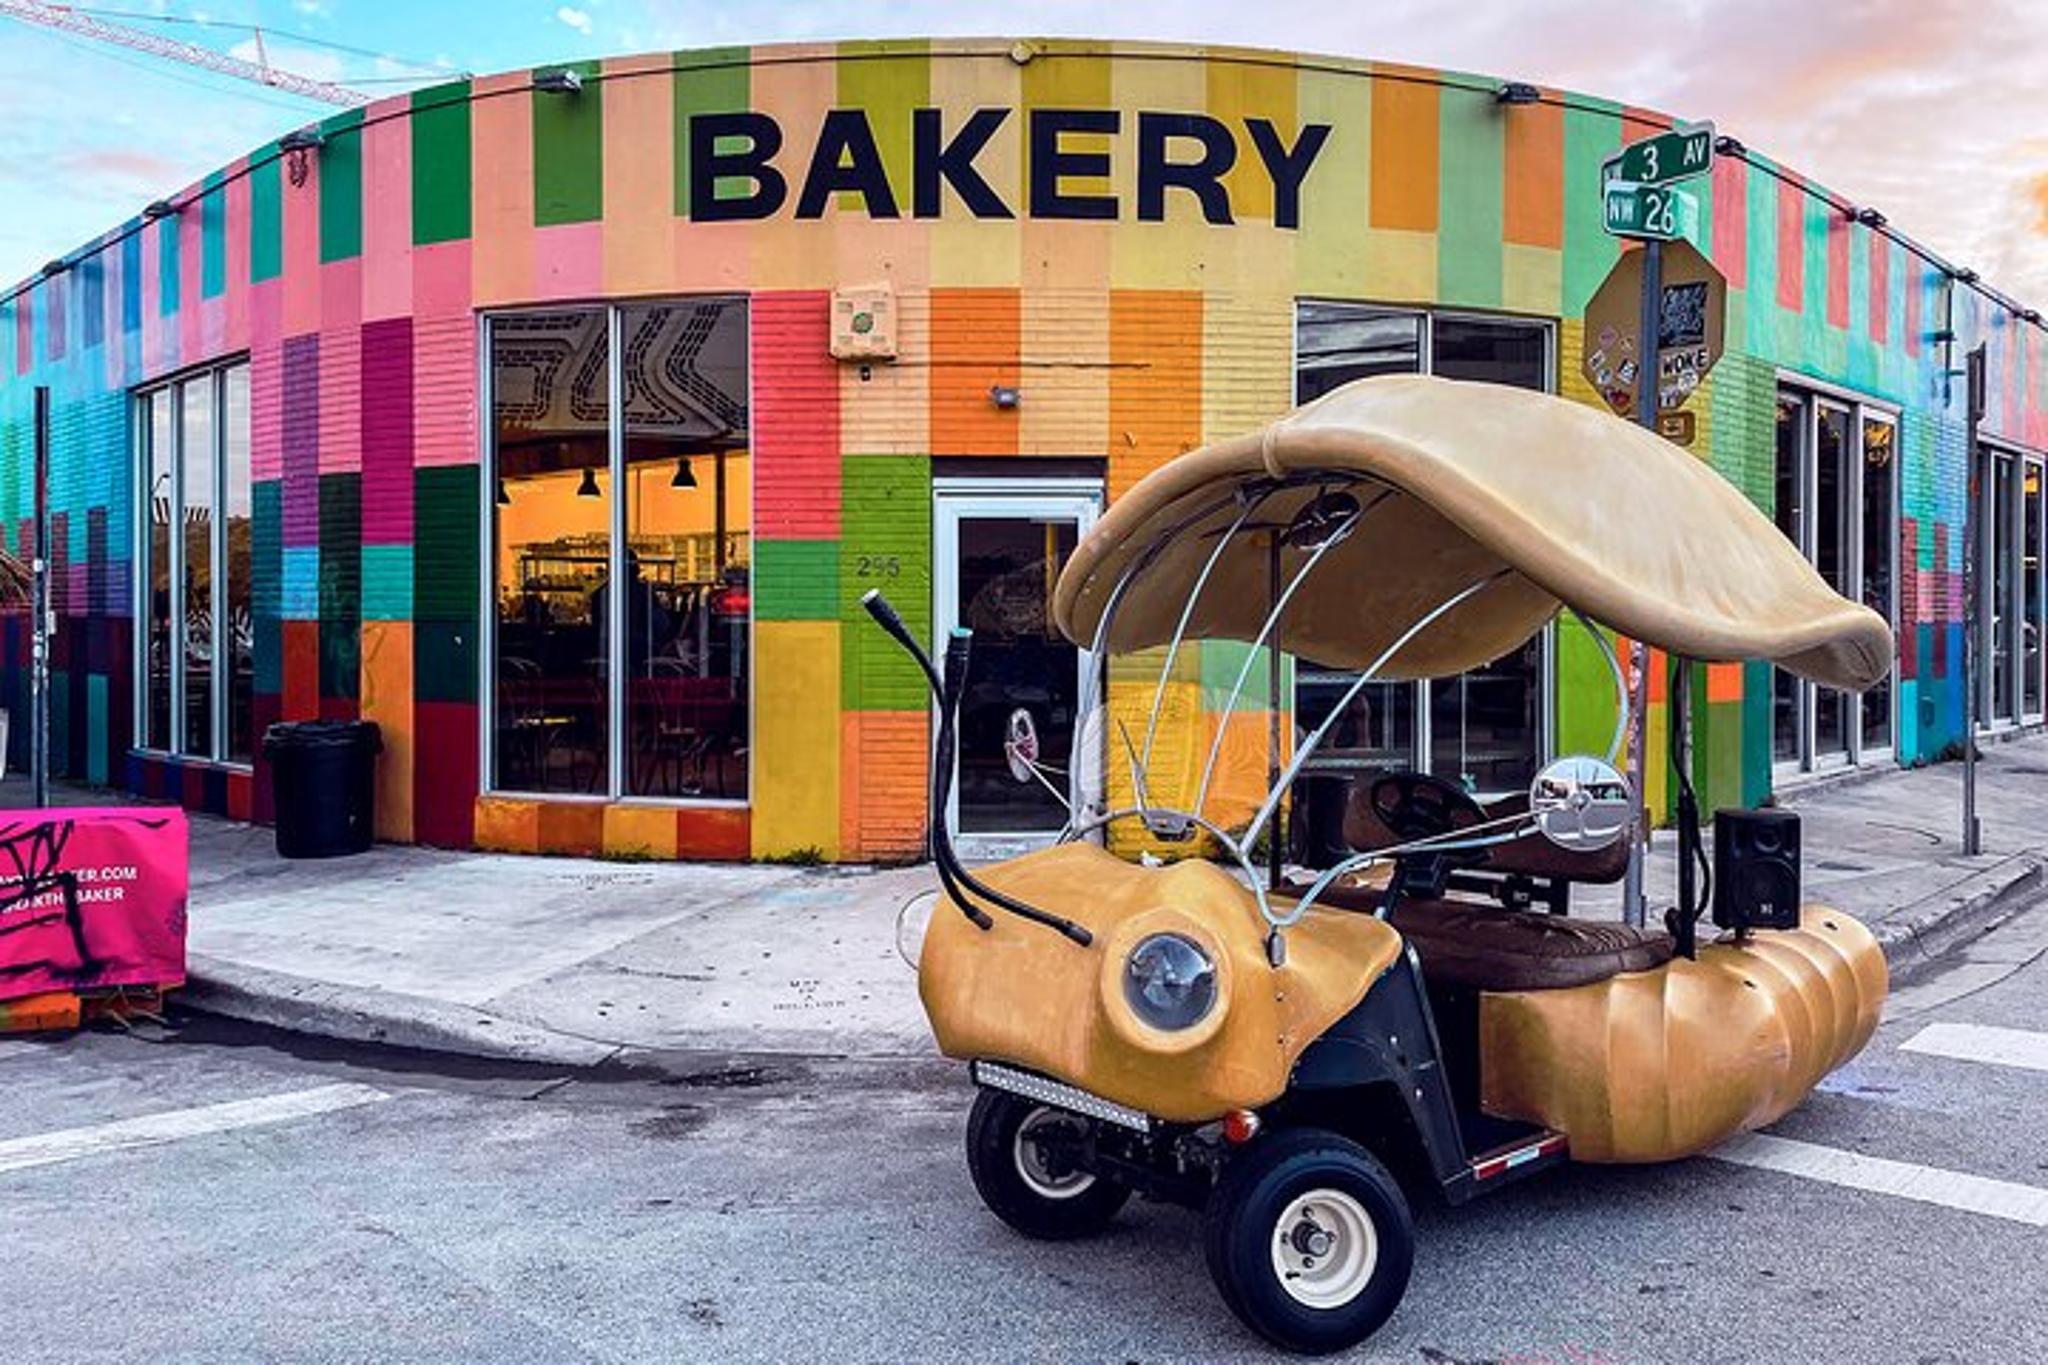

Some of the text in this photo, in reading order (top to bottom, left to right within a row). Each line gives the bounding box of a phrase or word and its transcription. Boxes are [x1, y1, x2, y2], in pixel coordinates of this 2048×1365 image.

[689, 108, 1332, 230] BAKERY
[1641, 145, 1659, 180] 3
[1682, 136, 1707, 166] AV
[1608, 193, 1675, 234] NW 26
[858, 556, 900, 578] 295
